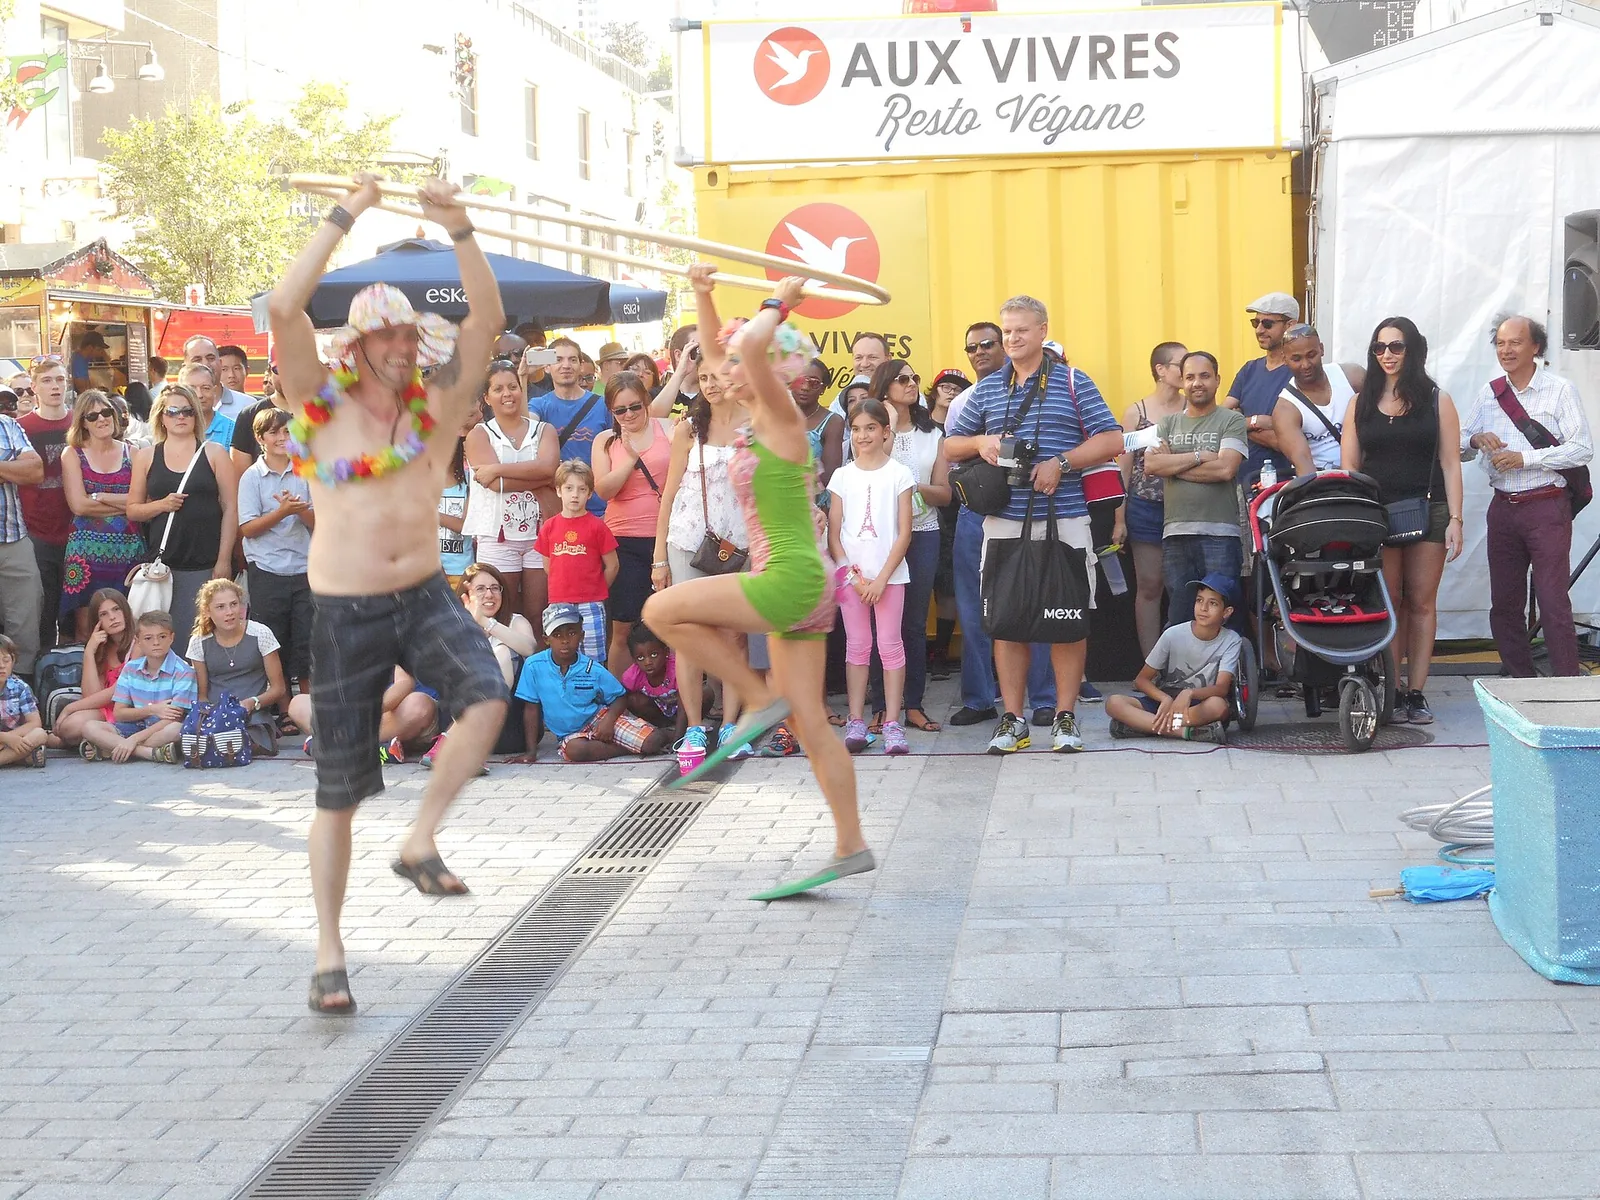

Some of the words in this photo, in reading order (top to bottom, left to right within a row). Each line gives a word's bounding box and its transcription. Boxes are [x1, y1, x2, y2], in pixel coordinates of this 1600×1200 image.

[841, 39, 962, 88] AUX
[981, 31, 1181, 84] VIVRES
[875, 93, 982, 153] Resto
[995, 93, 1145, 146] Végane
[809, 331, 913, 359] VIVES
[1168, 432, 1218, 446] SCIENCE
